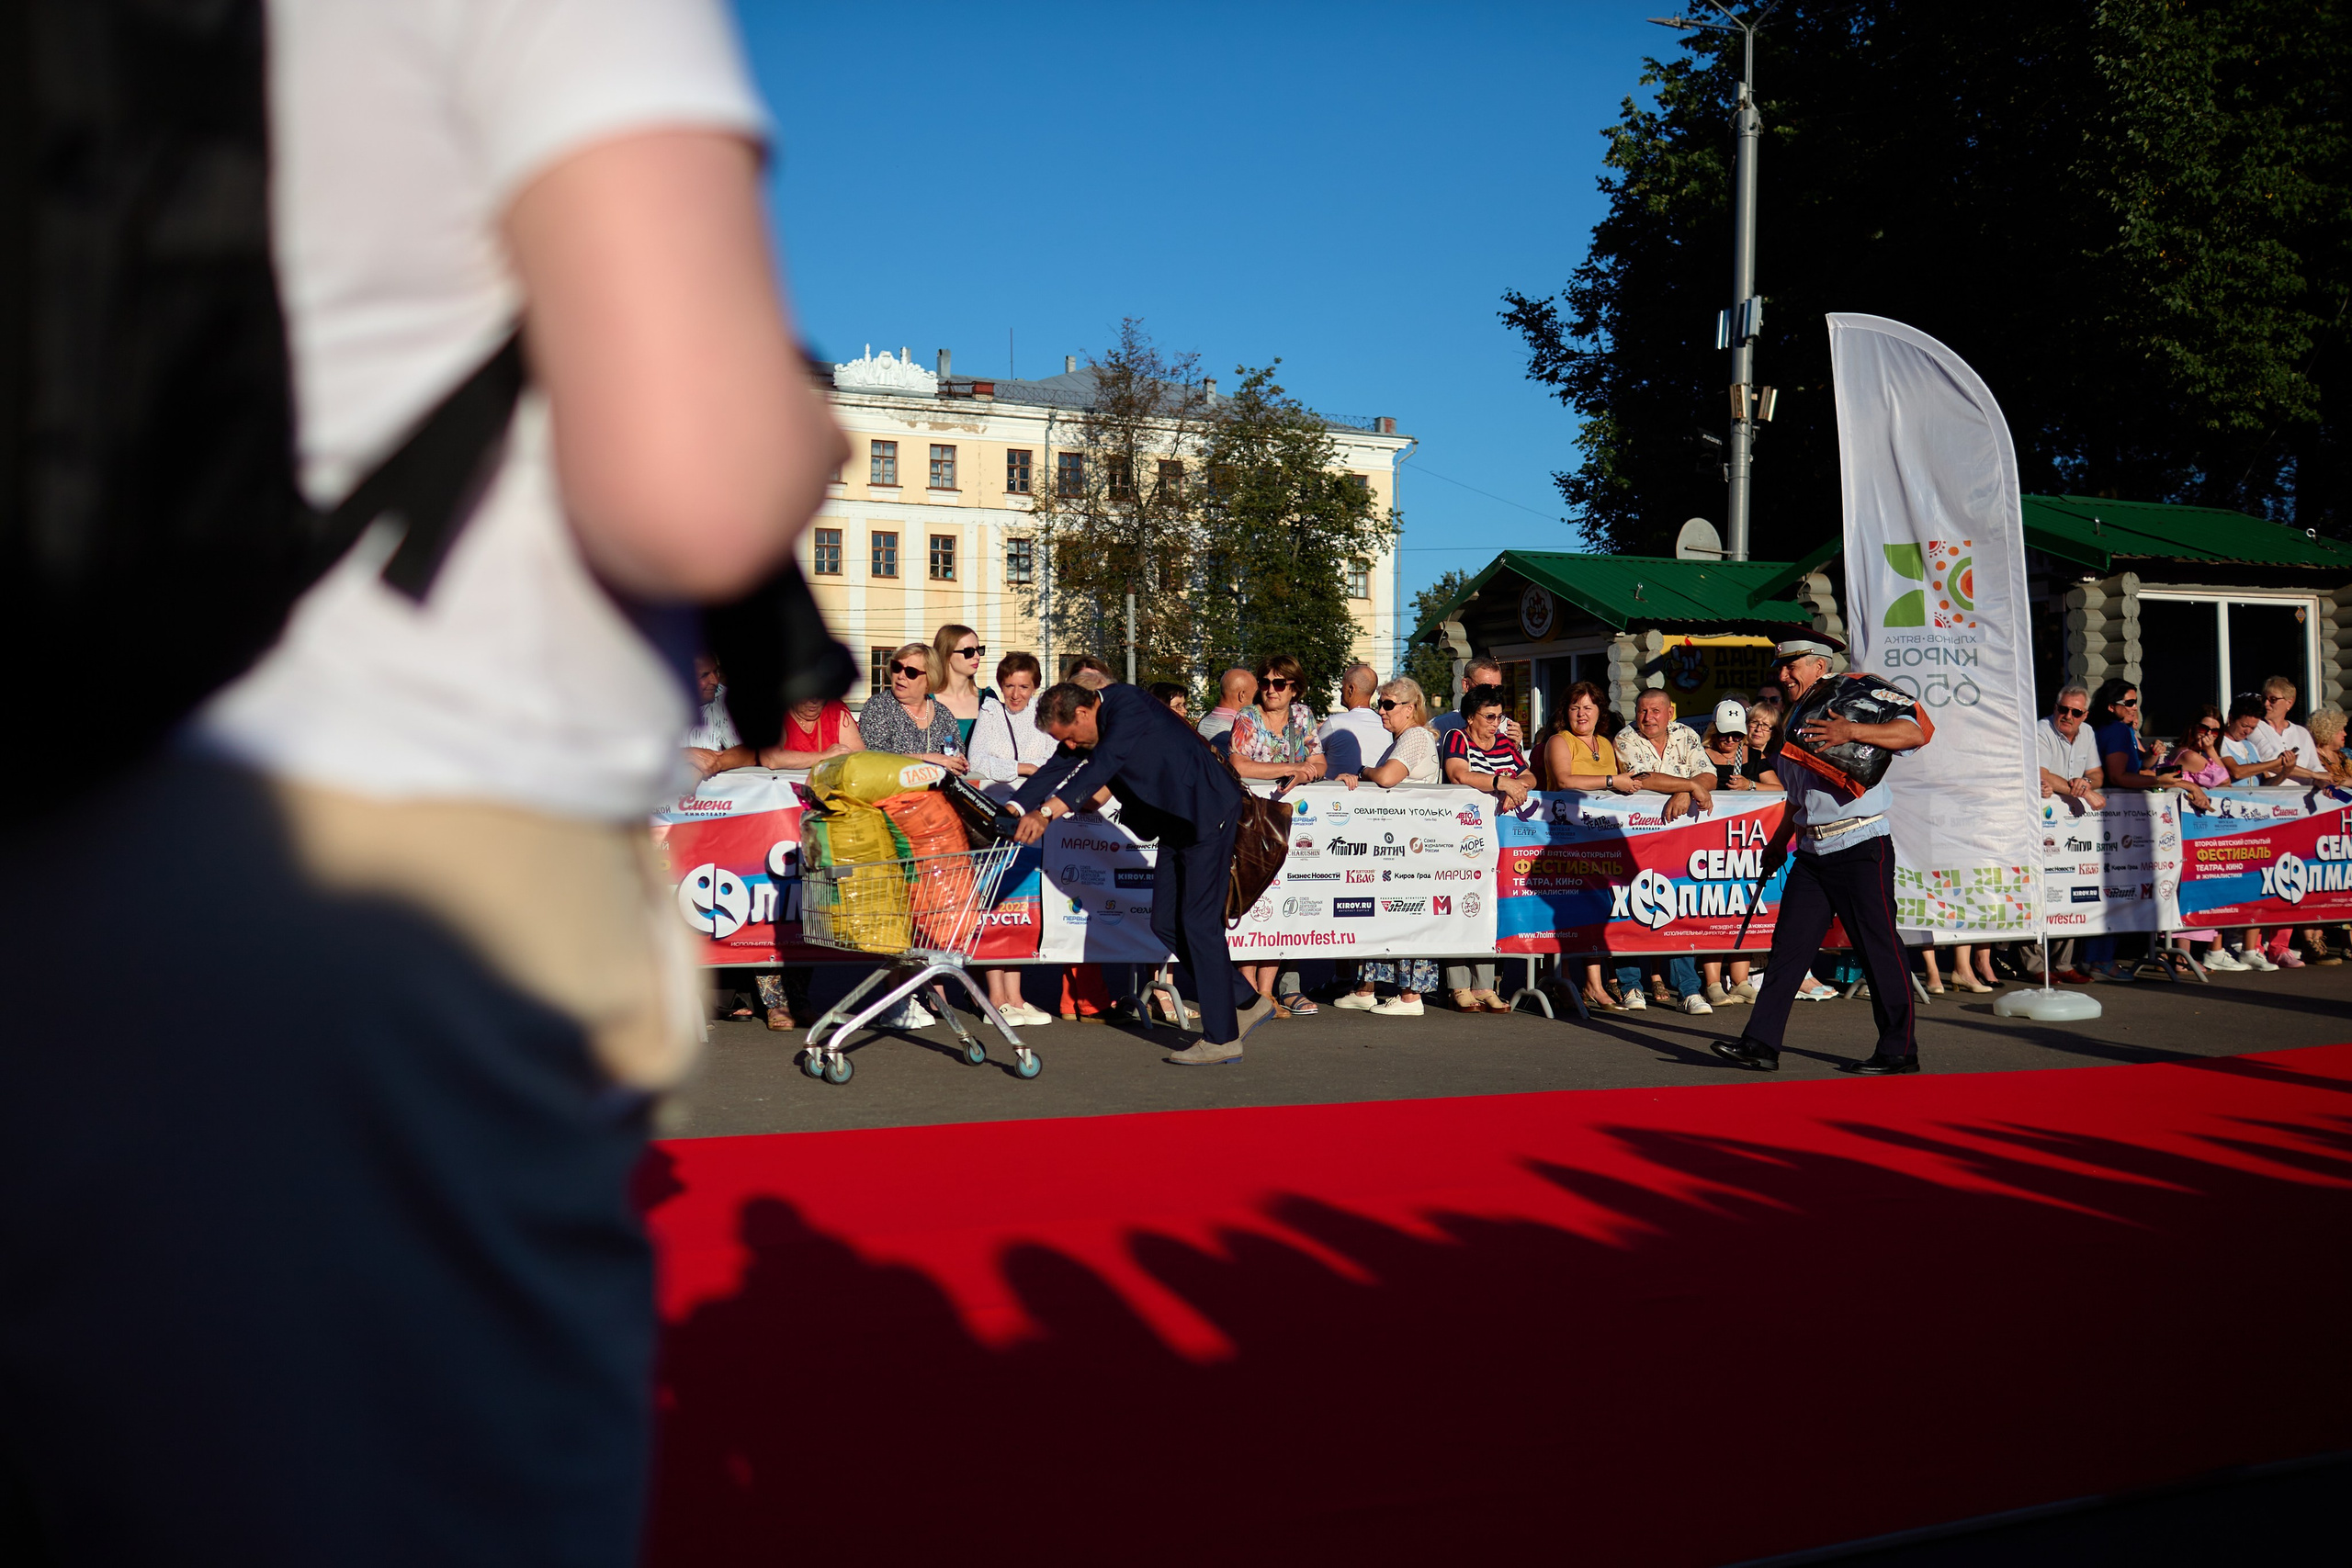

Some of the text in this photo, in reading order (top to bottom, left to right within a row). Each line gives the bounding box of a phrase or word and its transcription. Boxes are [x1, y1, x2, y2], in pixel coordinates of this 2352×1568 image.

[903, 765, 941, 784] TASTY
[678, 795, 733, 811] Смена
[1628, 812, 1666, 826] Смена
[1727, 819, 1768, 847] НА
[1061, 837, 1109, 852] МАРИЯ
[1374, 844, 1406, 857] ВЯТИЧ
[1459, 837, 1485, 852] МОРЕ
[1512, 848, 1545, 857] ВТОРОЙ
[1581, 850, 1623, 859] ОТКРЫТЫЙ
[2197, 846, 2272, 863] ФЕСТИВАЛЬ
[1513, 858, 1624, 875] ФЕСТИВАЛЬ
[2226, 863, 2244, 872] КИНО
[1434, 870, 1473, 880] МАРИЯ
[1512, 878, 1583, 887] ТЕАТРА, КИНО
[1521, 888, 1579, 897] ЖУРНАЛИСТИКИ
[999, 902, 1029, 912] 2023
[977, 912, 1032, 925] ГУСТА
[1227, 930, 1356, 947] w.7holmovfest.ru
